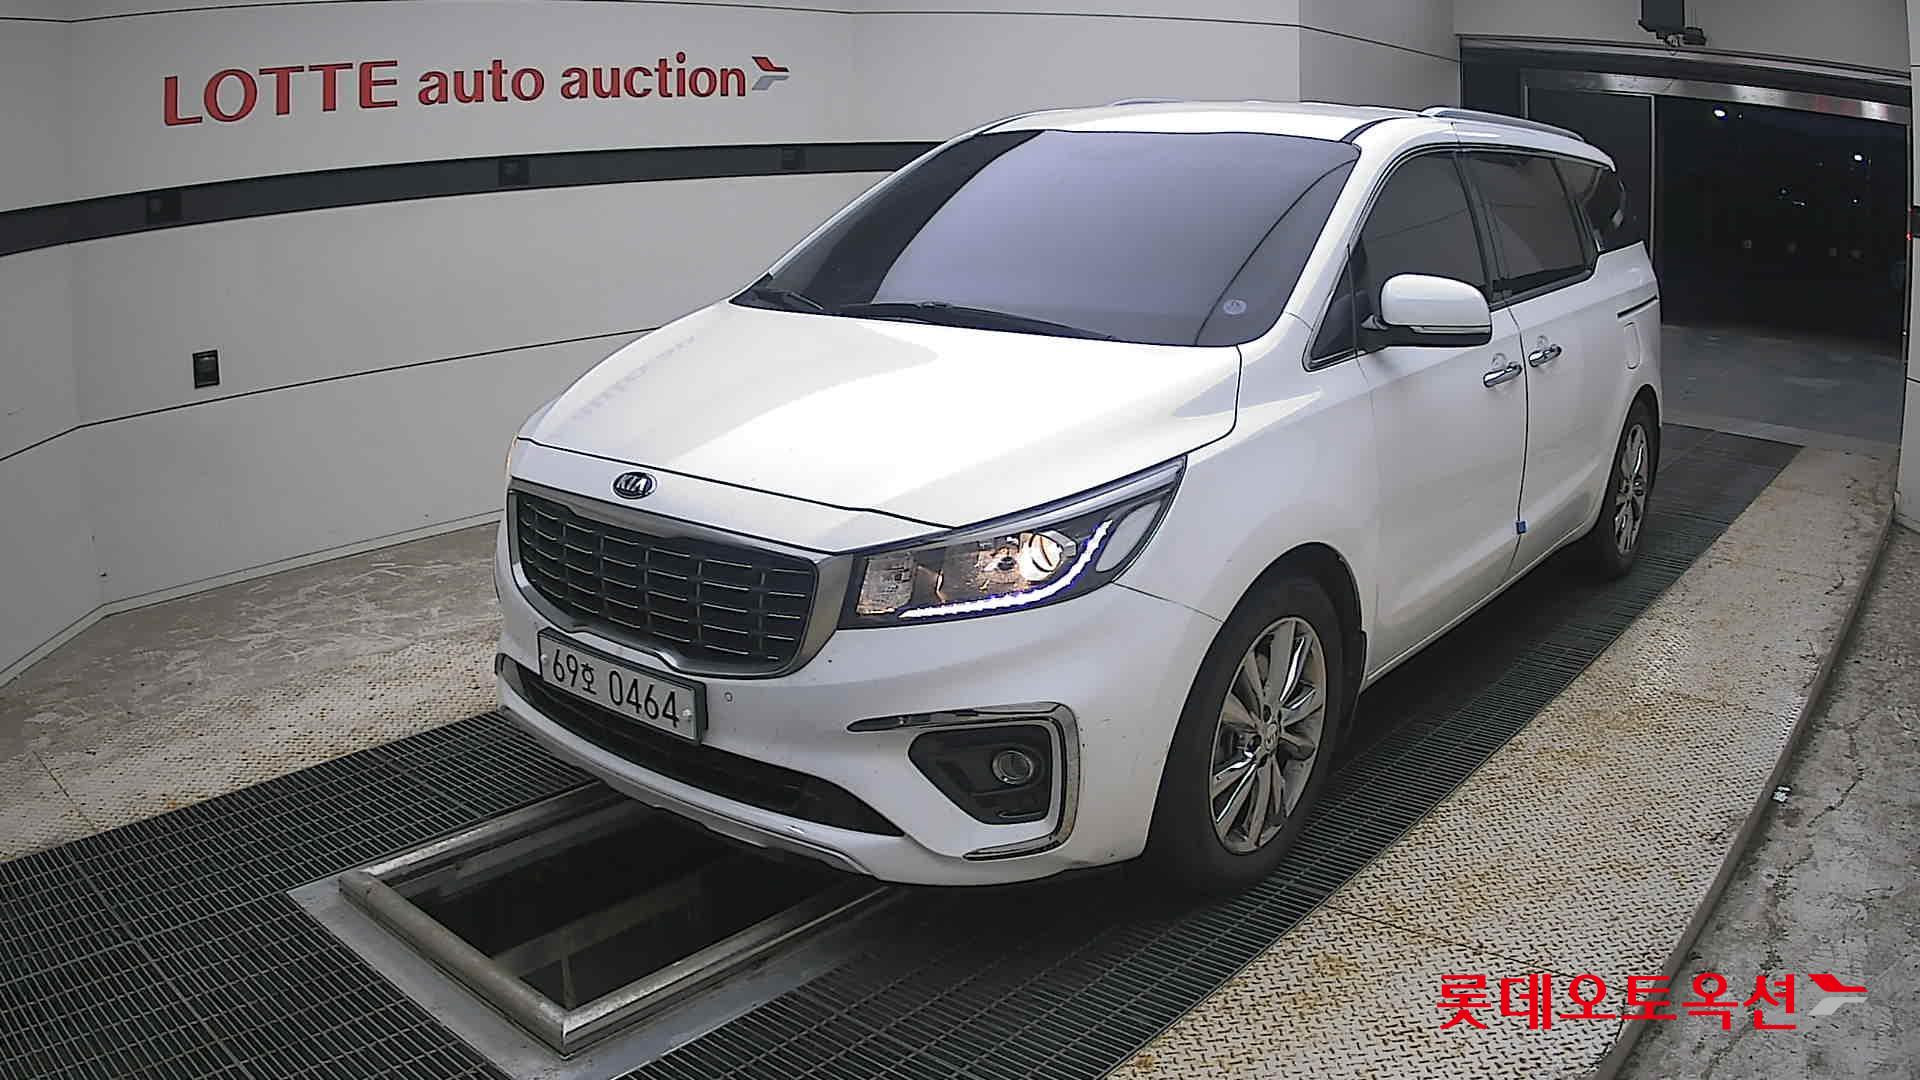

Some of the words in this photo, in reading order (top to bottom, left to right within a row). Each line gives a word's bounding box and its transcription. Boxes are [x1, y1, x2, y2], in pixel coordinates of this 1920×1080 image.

[163, 59, 399, 126] LOTTE
[417, 58, 546, 106] auto
[560, 51, 748, 101] auction
[552, 649, 597, 695] 69호
[608, 670, 681, 728] 0464
